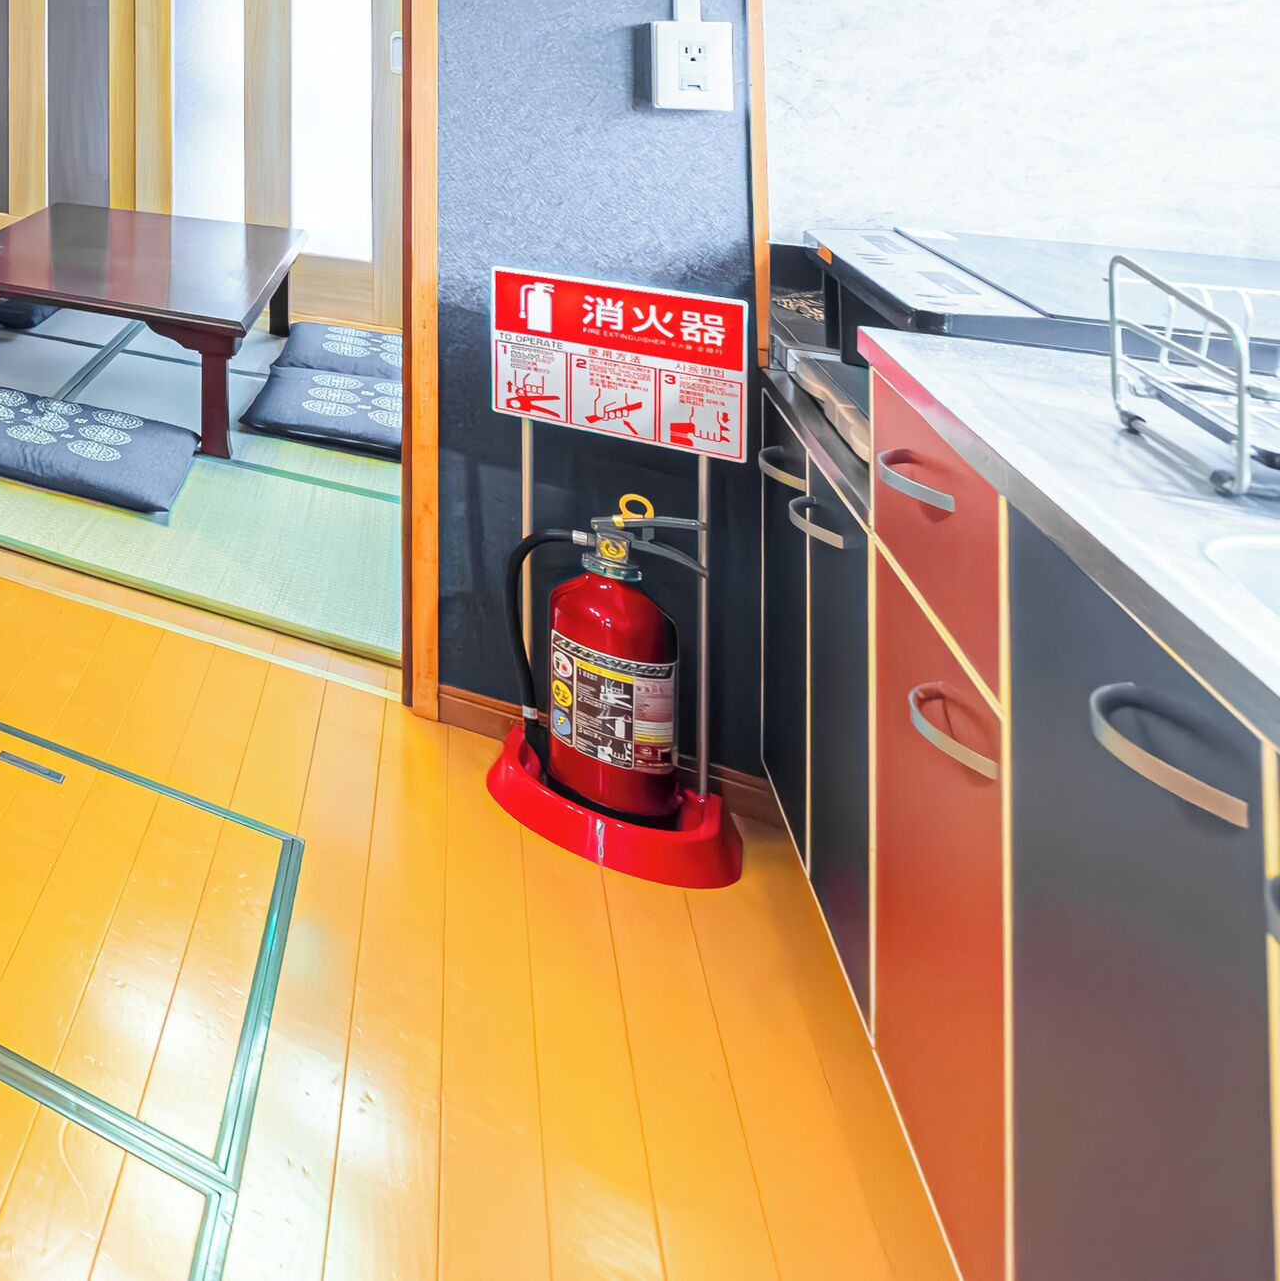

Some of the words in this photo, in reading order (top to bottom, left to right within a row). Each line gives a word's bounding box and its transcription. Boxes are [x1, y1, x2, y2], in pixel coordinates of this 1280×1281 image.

[582, 295, 725, 347] 消火器
[499, 332, 512, 341] TO
[515, 335, 563, 350] OPERATE
[582, 327, 601, 336] FIRE
[603, 330, 667, 346] EXTINGUISHER
[501, 344, 507, 355] 1
[588, 348, 641, 364] 使用方法
[576, 358, 587, 369] 2
[664, 374, 677, 385] 3
